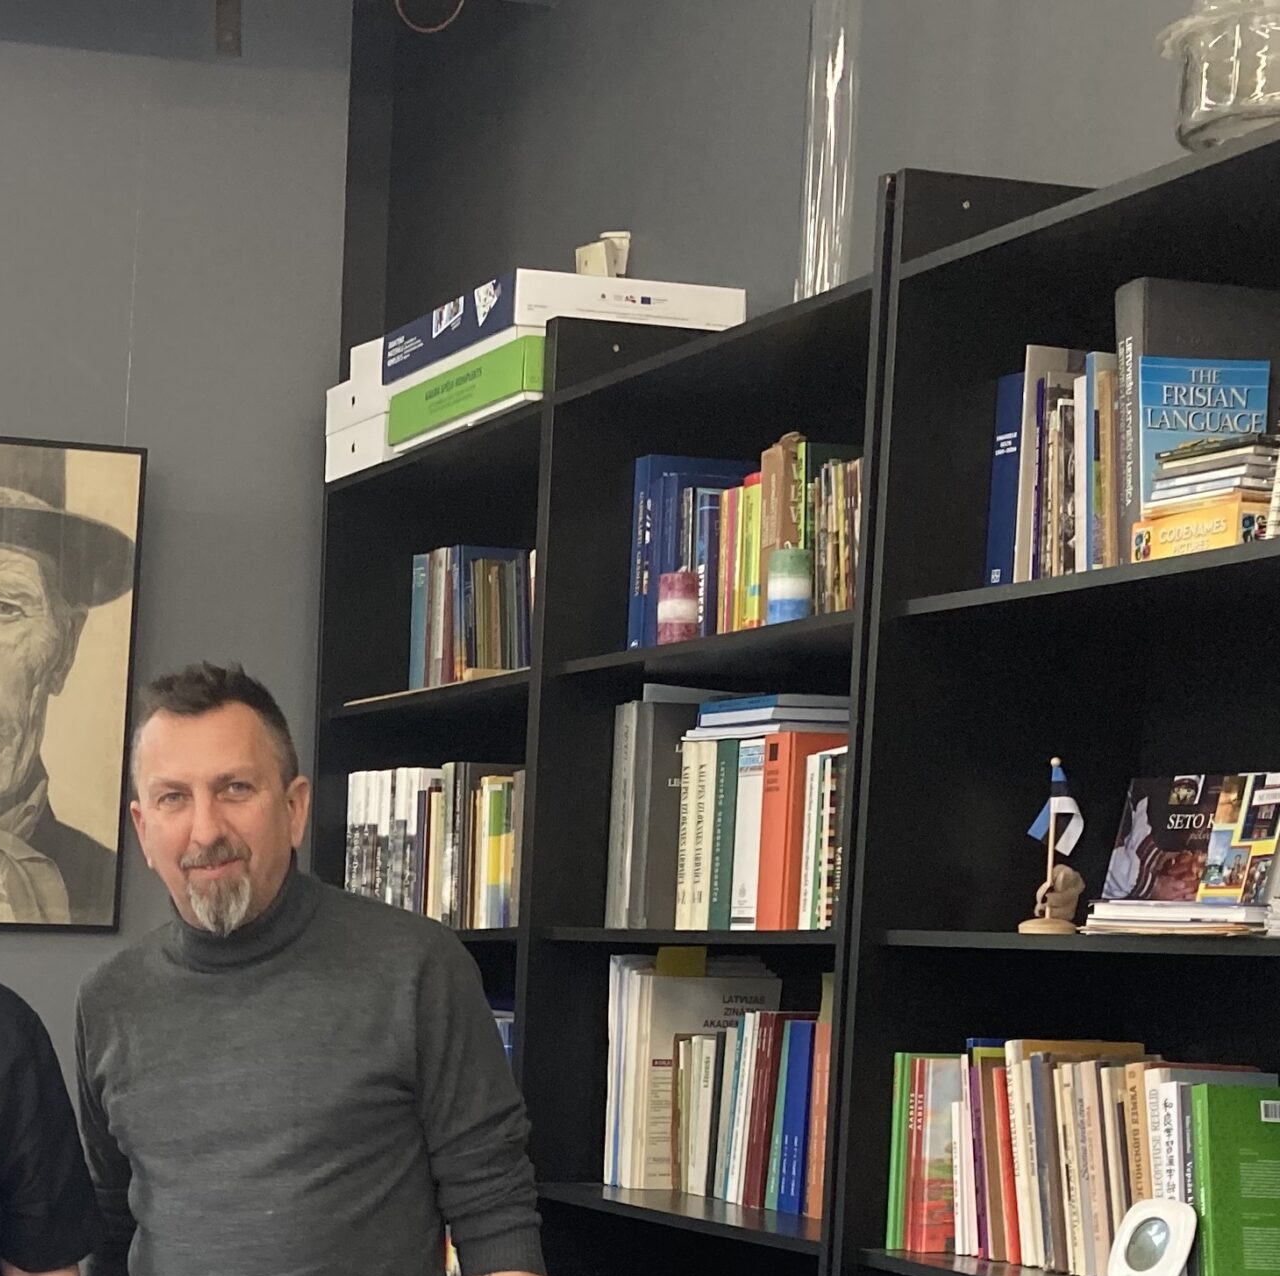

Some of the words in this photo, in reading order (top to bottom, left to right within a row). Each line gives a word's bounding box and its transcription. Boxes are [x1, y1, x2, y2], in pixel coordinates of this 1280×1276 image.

[1188, 367, 1222, 384] THE
[1162, 384, 1250, 409] FRISIAN
[1147, 408, 1267, 434] LANGUAGE
[1159, 517, 1227, 544] CODENAMES
[1167, 812, 1204, 830] SETO
[722, 994, 765, 1005] LATVIJAS
[1128, 1084, 1140, 1125] ЯЗЫКА
[1149, 1088, 1161, 1131] REEGLID
